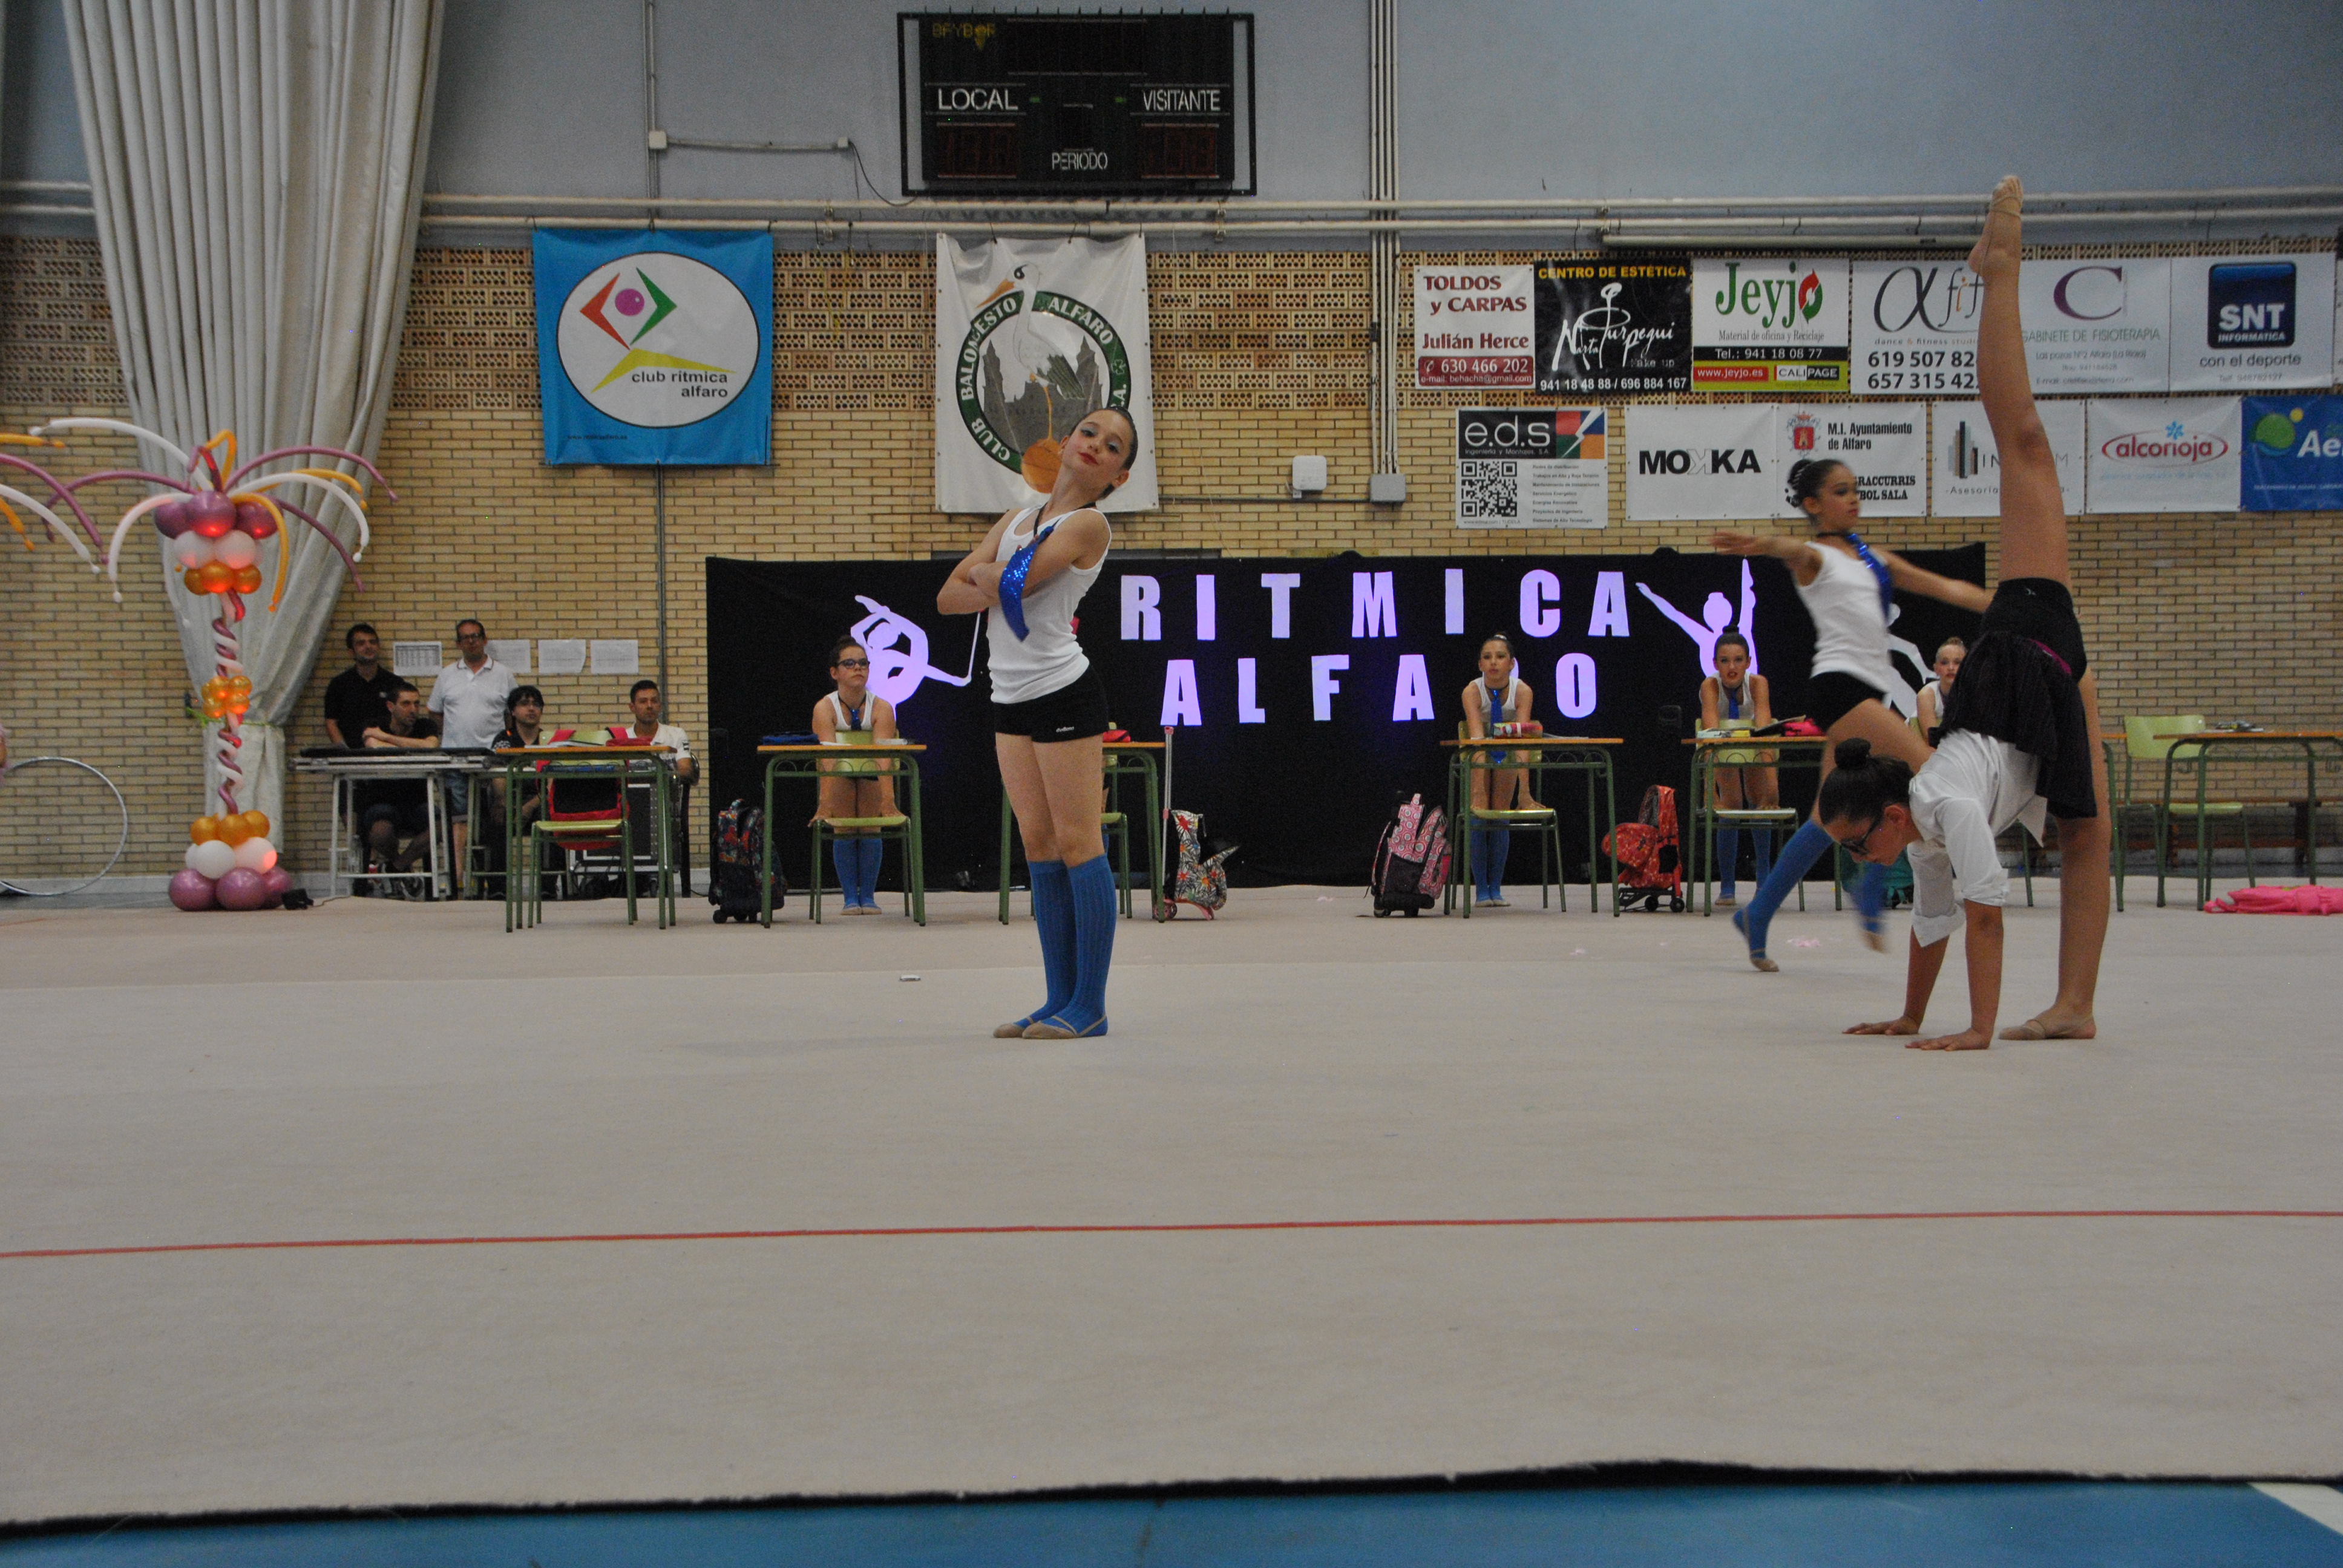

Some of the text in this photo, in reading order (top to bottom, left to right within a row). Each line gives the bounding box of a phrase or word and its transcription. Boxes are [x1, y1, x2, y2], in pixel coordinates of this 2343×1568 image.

[938, 88, 1018, 110] LOCAL
[1144, 89, 1221, 111] VISITANTE
[1052, 151, 1107, 170] PERIODO
[1538, 267, 1594, 279] CENTRO
[1599, 266, 1616, 278] DE
[1423, 275, 1502, 290] TOLDOS
[1715, 261, 1823, 328] Jeyjo
[2054, 266, 2122, 321] C
[1430, 296, 1527, 315] y CARPAS
[2219, 303, 2285, 331] SNT
[1423, 333, 1529, 349] Julián Herce
[1719, 330, 1824, 343] Material de oficina y Reciclaje
[2073, 329, 2086, 342] DE
[2092, 327, 2160, 342] FISIOTERAPIA
[1715, 348, 1822, 358] Tel.: 941 18 08 77
[1868, 351, 1904, 367] 619
[1910, 351, 1945, 367] 507
[2200, 353, 2301, 368] con el deporte
[1441, 358, 1528, 373] 630 466 202
[1698, 368, 1763, 378] www.jeyjo.es
[632, 371, 665, 383] club
[971, 417, 1010, 461] CLUB
[1048, 296, 1113, 344] ALFARO
[1541, 379, 1559, 390] 941
[1565, 379, 1577, 390] 18
[1581, 379, 1594, 391] 48
[1598, 379, 1611, 390] 88
[1621, 379, 1640, 390] 696
[1644, 378, 1663, 389] 884
[1668, 377, 1686, 388] 167
[1868, 373, 1978, 389] 657 315 42
[681, 385, 728, 397] alfaro
[1465, 414, 1550, 446] e.d.s
[1828, 422, 1912, 436] M.I. Ayuntamiento
[1828, 437, 1871, 449] de Alfaro
[2116, 436, 2212, 462] alcorioja
[2297, 430, 2343, 458] Ae
[1881, 490, 1908, 500] SALA
[1121, 569, 1630, 640] RITMICA
[1160, 653, 1597, 726] ALFAO
